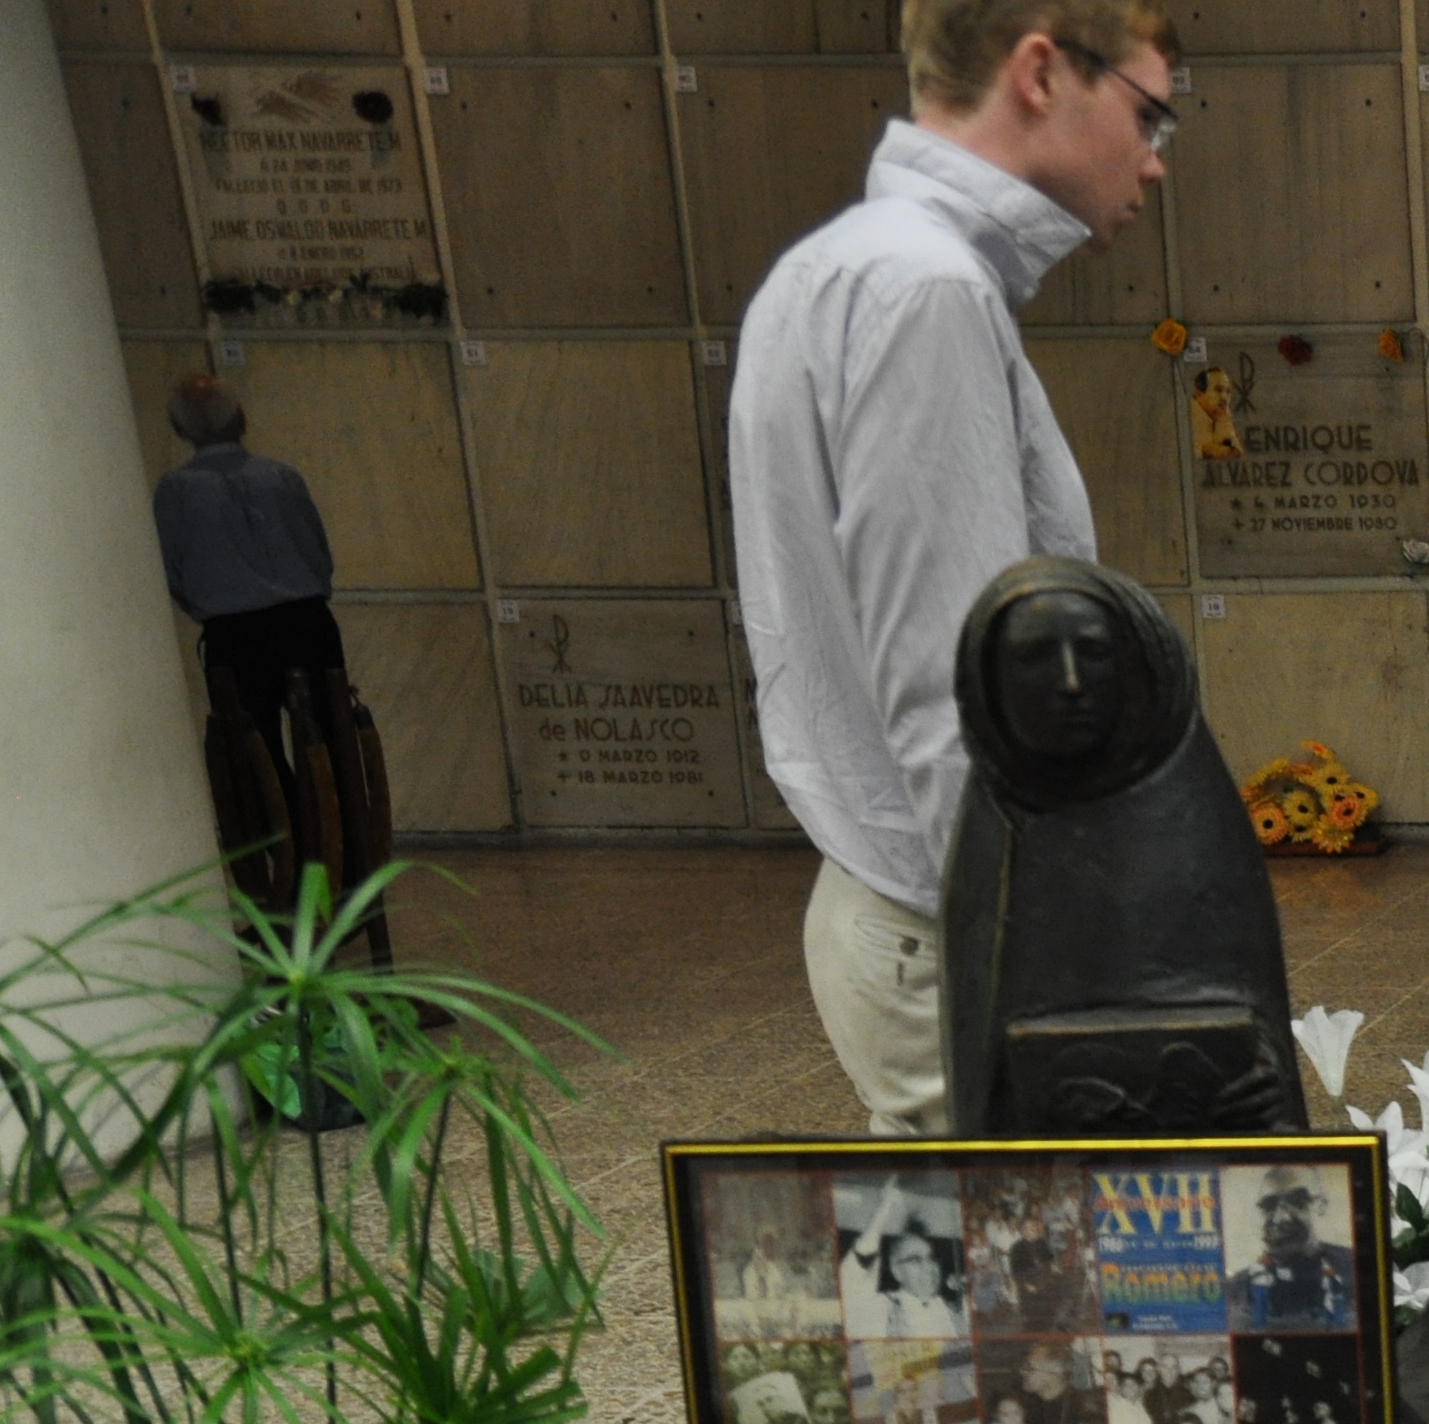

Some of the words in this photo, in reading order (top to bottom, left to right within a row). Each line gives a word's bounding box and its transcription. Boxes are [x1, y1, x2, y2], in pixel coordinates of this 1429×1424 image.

[1245, 425, 1373, 454] ENRIQUE
[1202, 460, 1292, 487] ALVAREZ
[1304, 459, 1420, 487] CORDOVA
[1274, 494, 1338, 508] MARZO
[1350, 494, 1396, 509] 1930
[1250, 517, 1266, 532] 27
[1272, 516, 1353, 532] NOVIEMBRE
[1358, 516, 1398, 531] 1980
[519, 683, 589, 709] DELIA
[600, 683, 720, 709] SAAVEDRA
[538, 717, 567, 742] de
[574, 717, 695, 743] NOLASCO
[600, 750, 659, 764] MARZO
[577, 770, 596, 784] 18
[603, 770, 663, 784] MARZO
[1093, 1172, 1218, 1236] XVII
[1101, 1262, 1222, 1304] Romero
